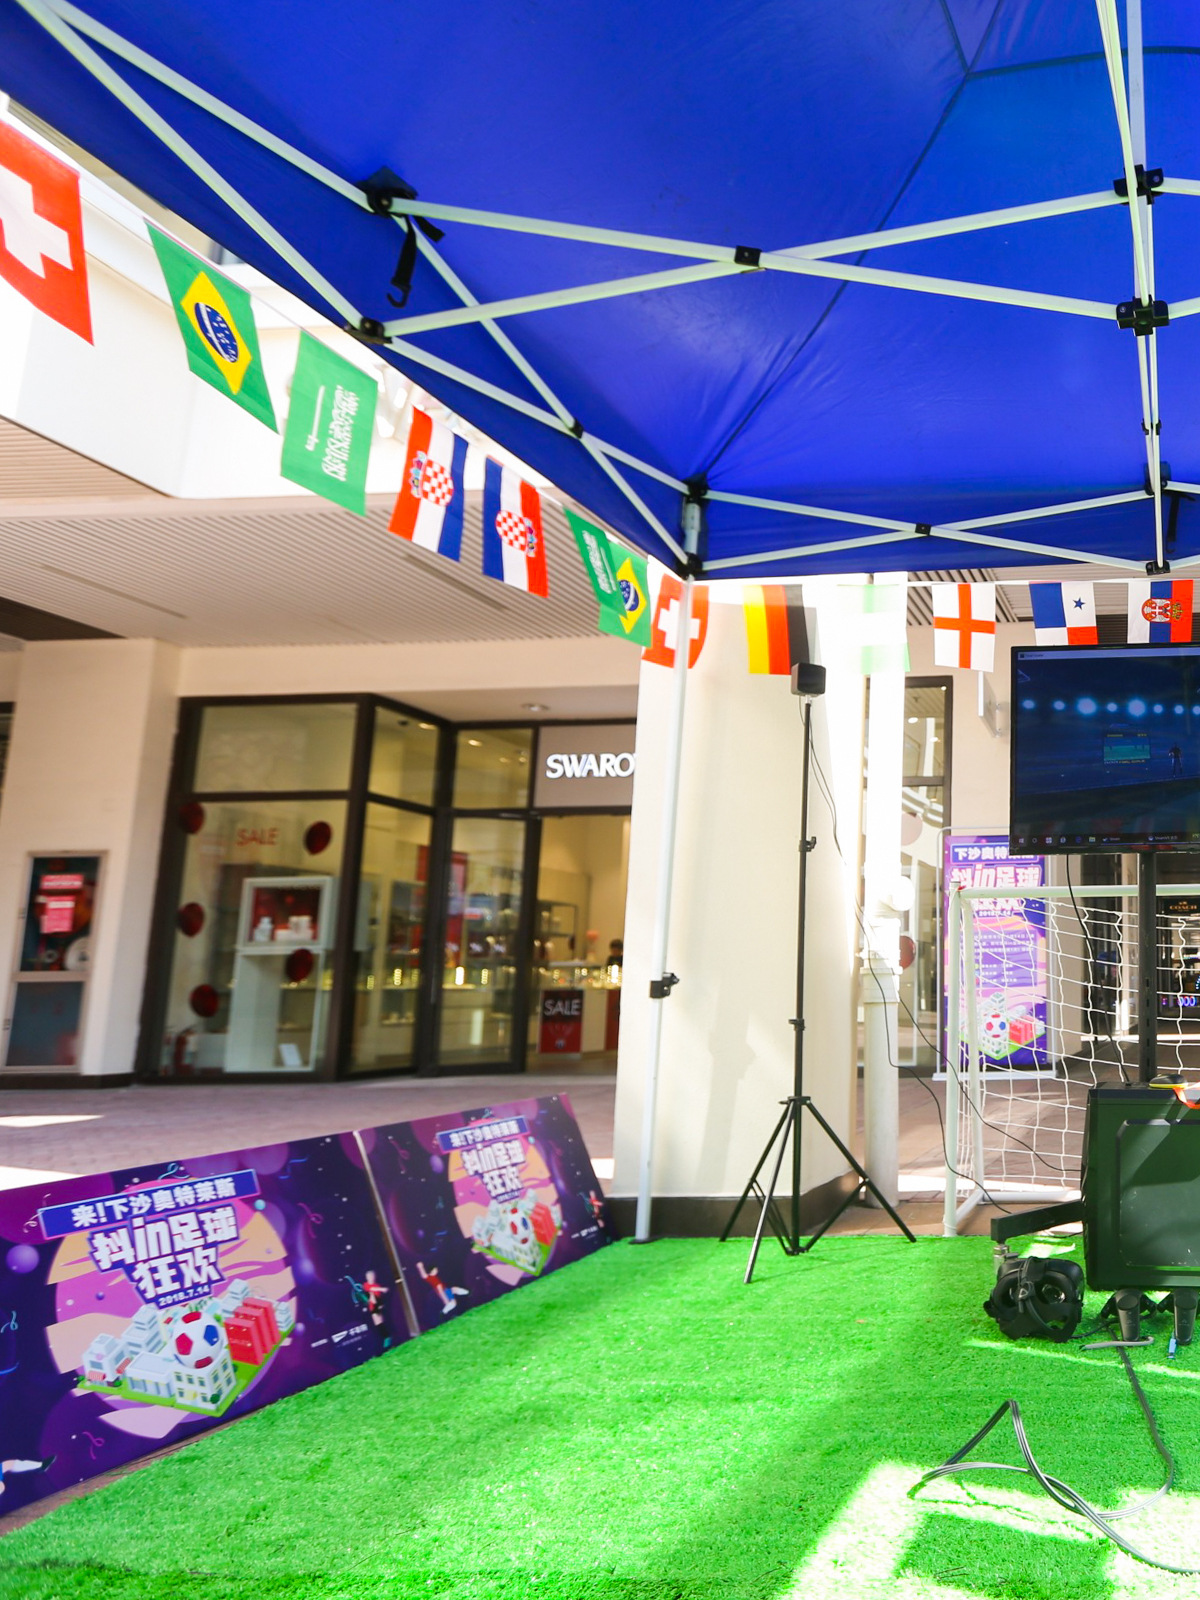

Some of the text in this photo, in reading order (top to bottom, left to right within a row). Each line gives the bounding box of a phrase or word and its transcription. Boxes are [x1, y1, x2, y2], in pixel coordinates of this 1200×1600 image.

[545, 752, 637, 779] SWARO
[236, 827, 279, 847] SALE
[954, 845, 1034, 860] 下沙奥特
[544, 998, 581, 1017] SALE
[91, 1205, 238, 1271] 抖in足球
[132, 1247, 222, 1299] 狂欢
[158, 1286, 211, 1306] 2018.7.14
